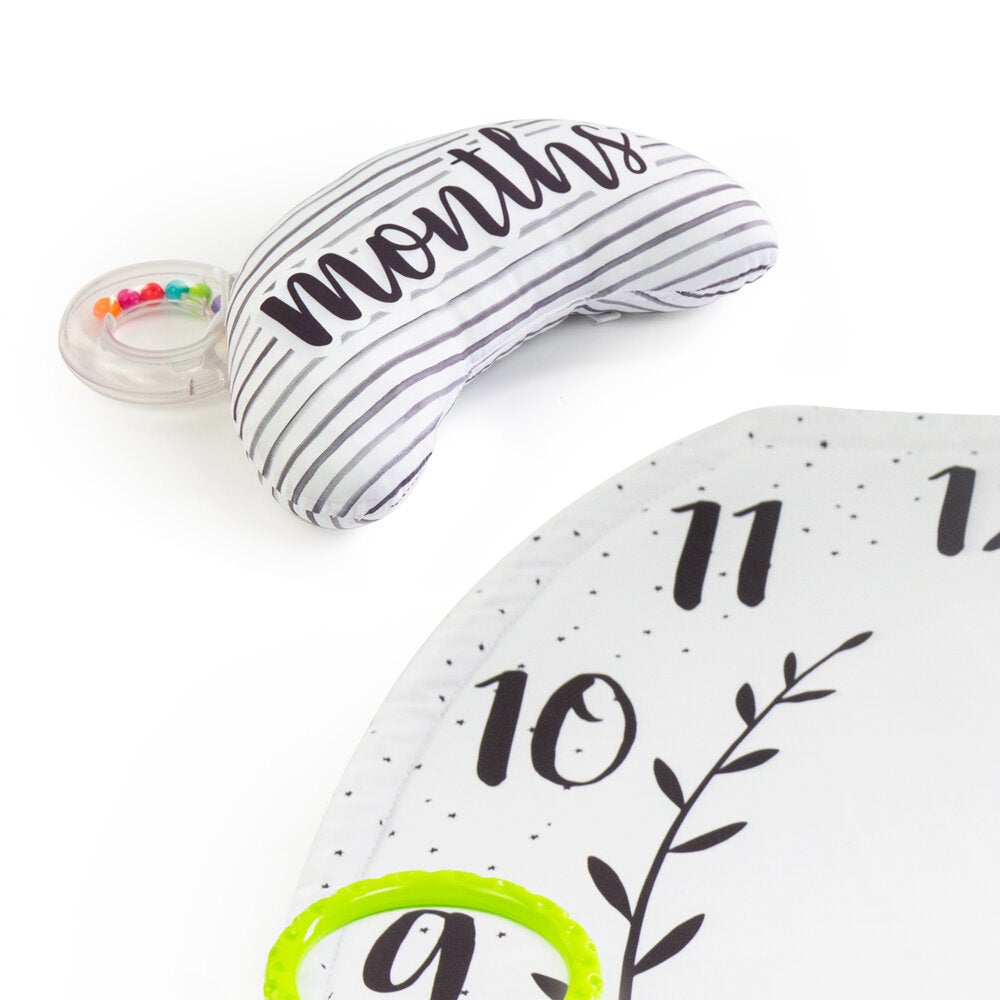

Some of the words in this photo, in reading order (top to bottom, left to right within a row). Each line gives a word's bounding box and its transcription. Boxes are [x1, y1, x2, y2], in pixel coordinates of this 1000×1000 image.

[260, 123, 647, 347] months
[671, 500, 784, 611] 11
[475, 669, 637, 788] 10
